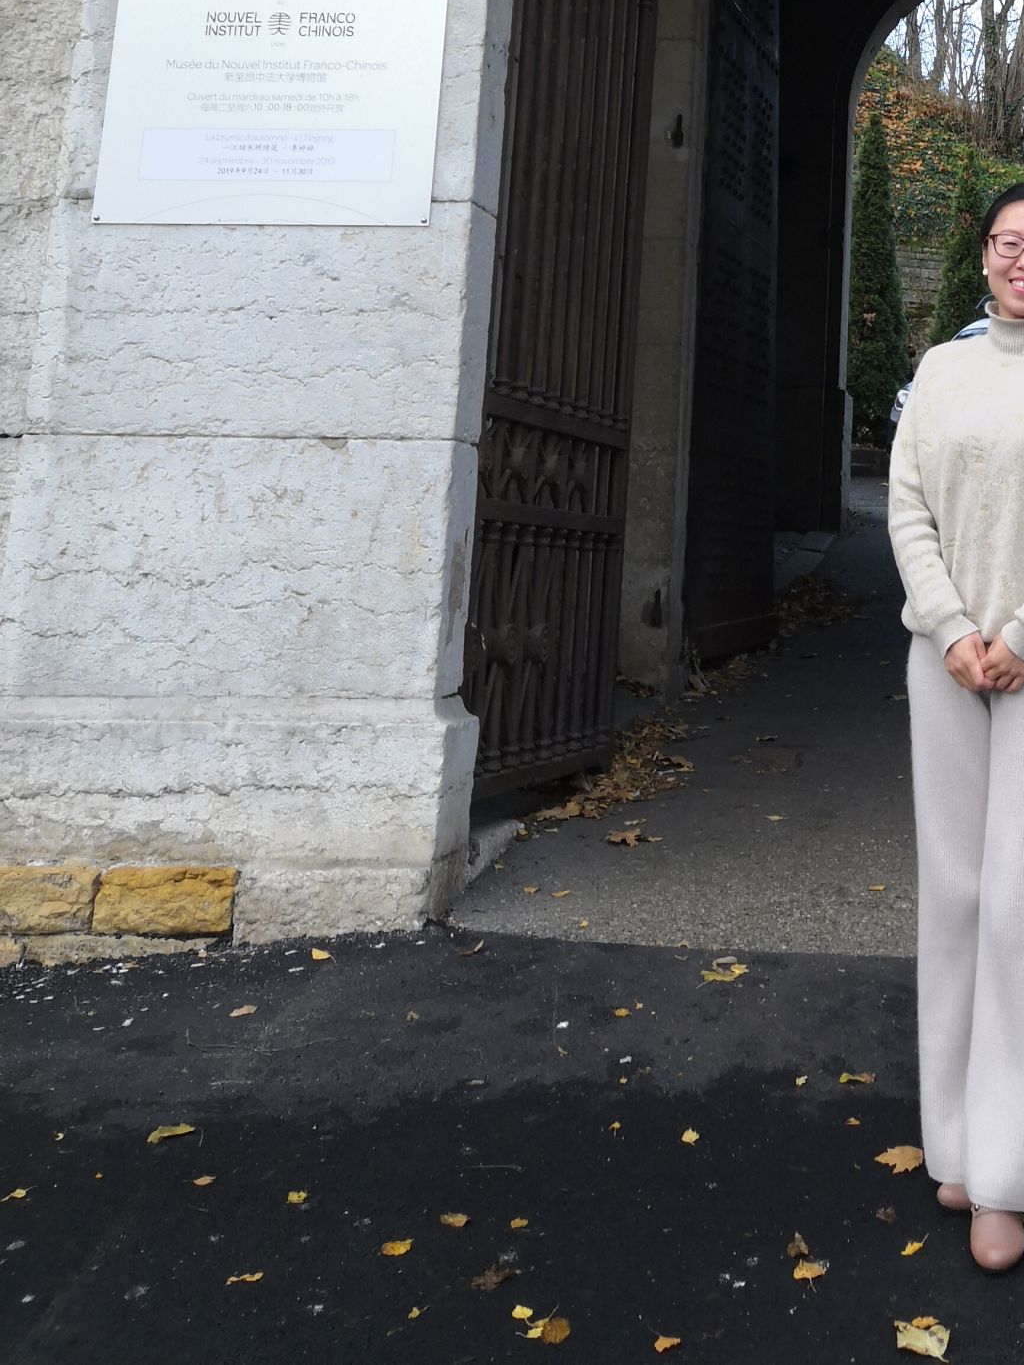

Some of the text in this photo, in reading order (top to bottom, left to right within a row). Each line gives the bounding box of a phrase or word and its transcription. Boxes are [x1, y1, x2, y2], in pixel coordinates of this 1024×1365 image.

[206, 11, 262, 24] NOUVEL
[299, 12, 356, 24] FRANCO
[205, 25, 262, 37] INSTITUT
[298, 26, 354, 38] CHINOIS
[166, 58, 388, 72] Musée du Nouvel Institut Franco-Chinois
